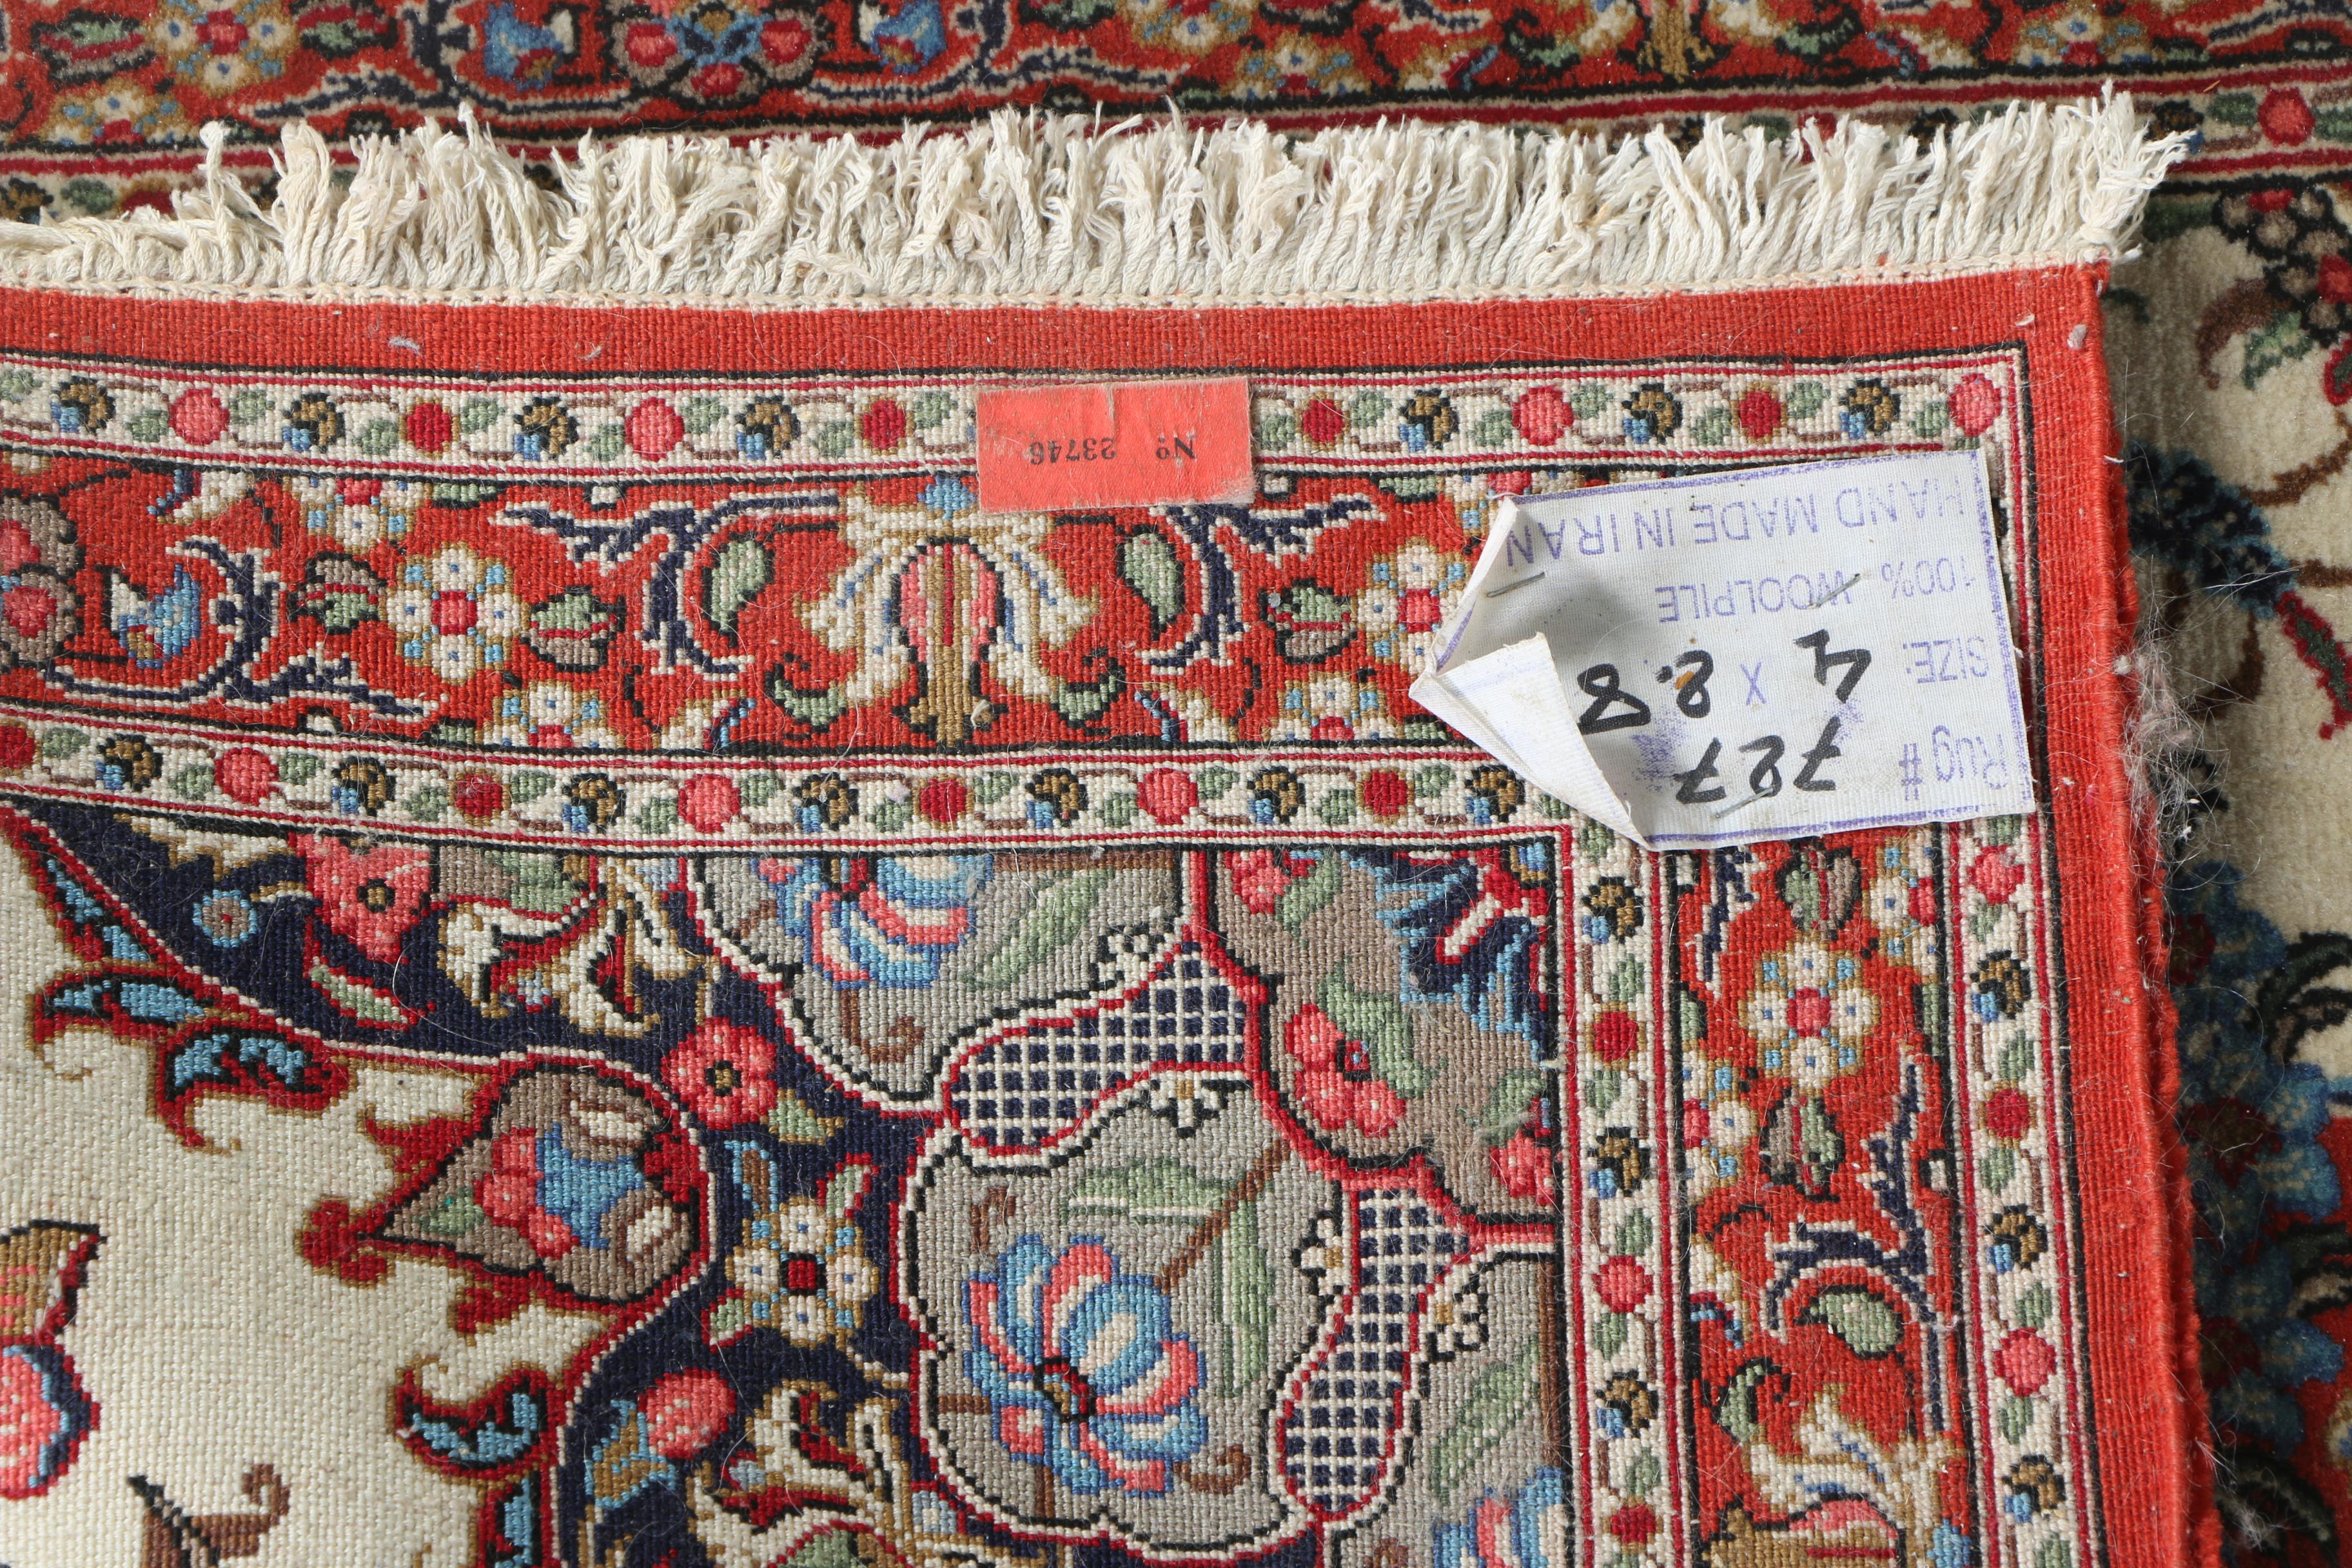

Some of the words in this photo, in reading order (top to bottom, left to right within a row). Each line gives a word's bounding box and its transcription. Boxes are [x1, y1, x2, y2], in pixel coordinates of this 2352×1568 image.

[1028, 436, 1116, 465] 23746
[1692, 493, 1819, 544] MADE
[1836, 477, 1965, 528] HAND
[1507, 514, 1620, 567] IRAN
[1635, 508, 1675, 551] IN
[1654, 569, 1852, 623] WOOLPILE
[1881, 555, 1975, 600] 100%
[1792, 628, 1872, 703] 4
[1902, 635, 1990, 684] SIZE:
[1932, 725, 2008, 790] Rug
